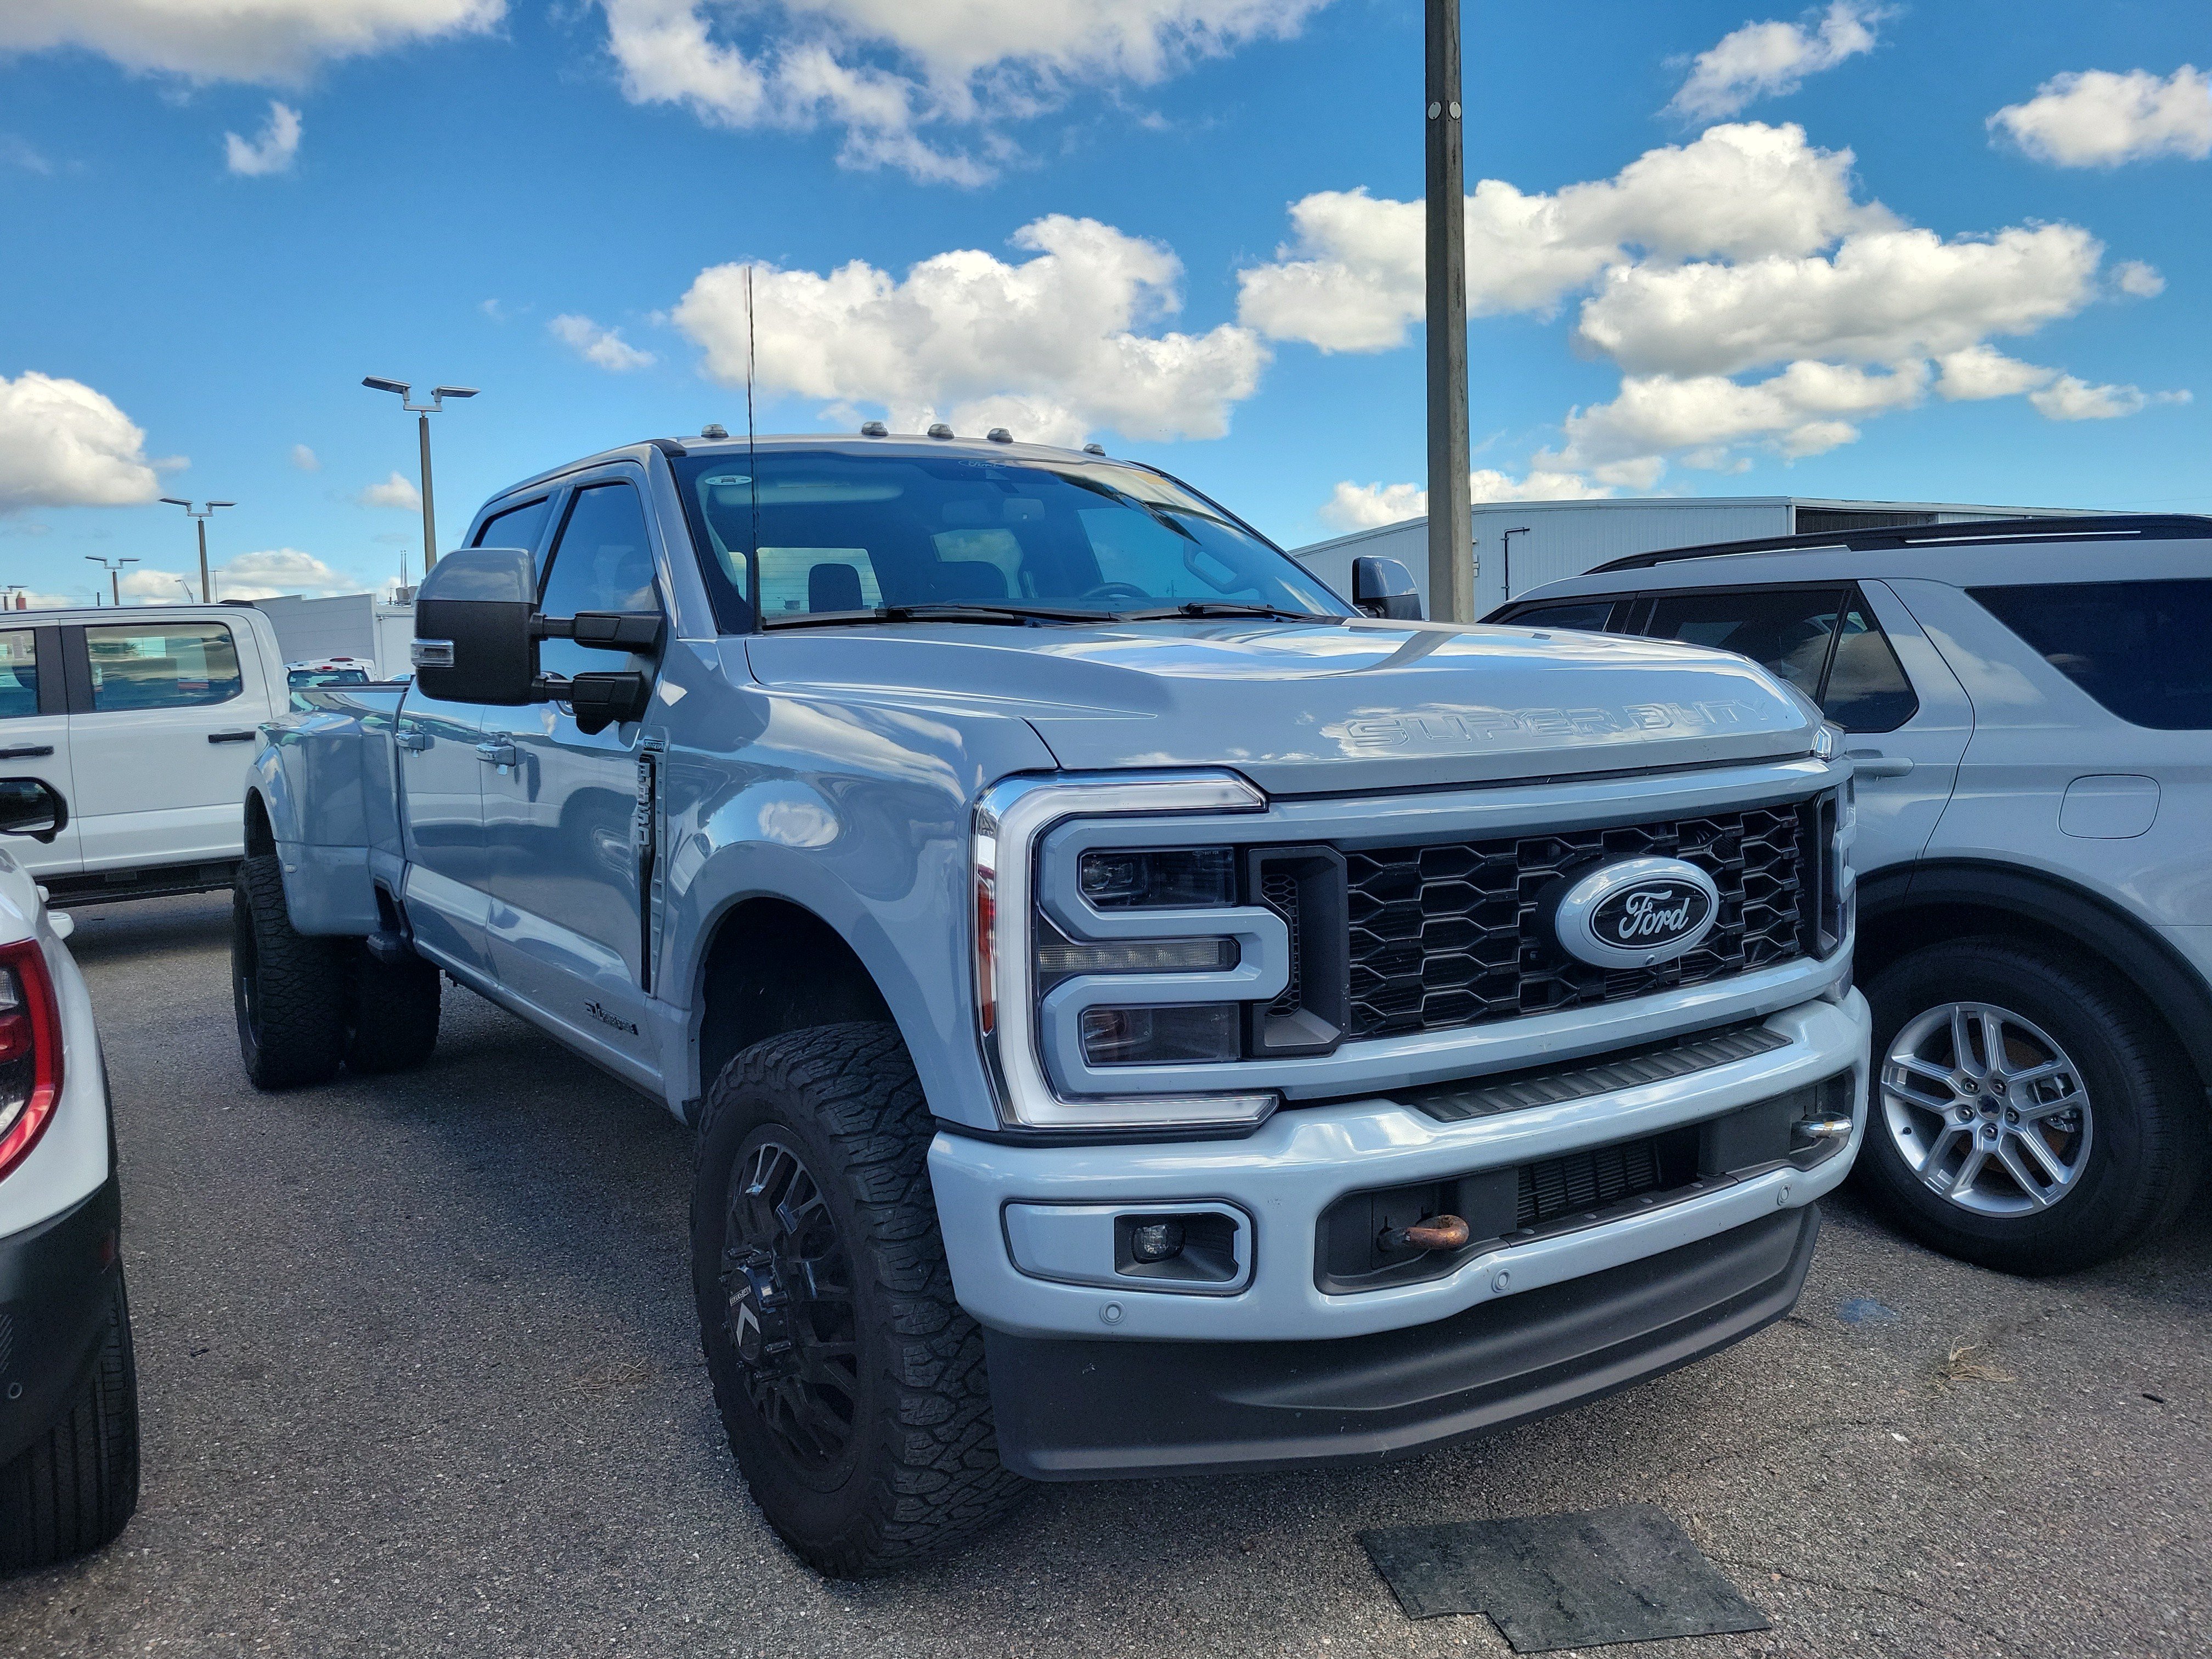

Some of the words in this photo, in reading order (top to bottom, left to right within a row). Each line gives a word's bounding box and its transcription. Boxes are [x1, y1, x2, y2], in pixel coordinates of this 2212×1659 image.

[1345, 708, 1623, 747] SUPER
[1622, 697, 1769, 731] DUTY
[1618, 890, 1690, 939] Ford
